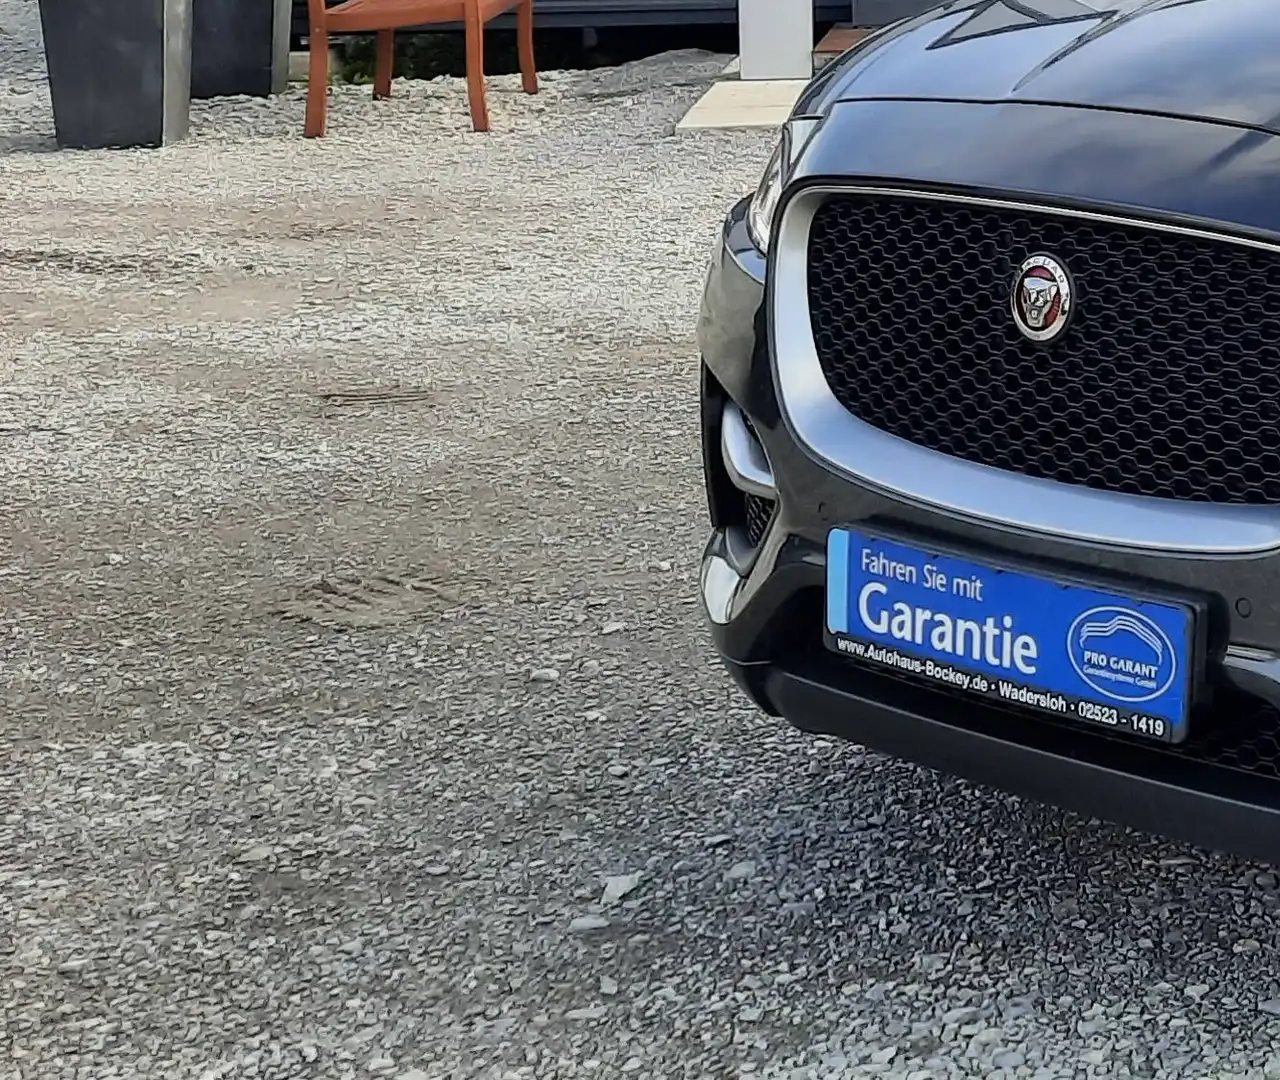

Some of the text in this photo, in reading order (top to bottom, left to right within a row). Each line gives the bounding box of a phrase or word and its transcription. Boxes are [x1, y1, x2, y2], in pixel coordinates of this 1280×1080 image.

[861, 548, 984, 602] Fahren Sie mit
[858, 581, 1038, 675] Garantie
[1083, 650, 1107, 666] PRO
[1109, 656, 1159, 679] GARANT
[837, 637, 989, 692] www.Autohaus-Bockey.de
[998, 680, 1067, 713] Wadersloh
[1078, 700, 1119, 725] 02523
[1131, 714, 1164, 737] 1419
